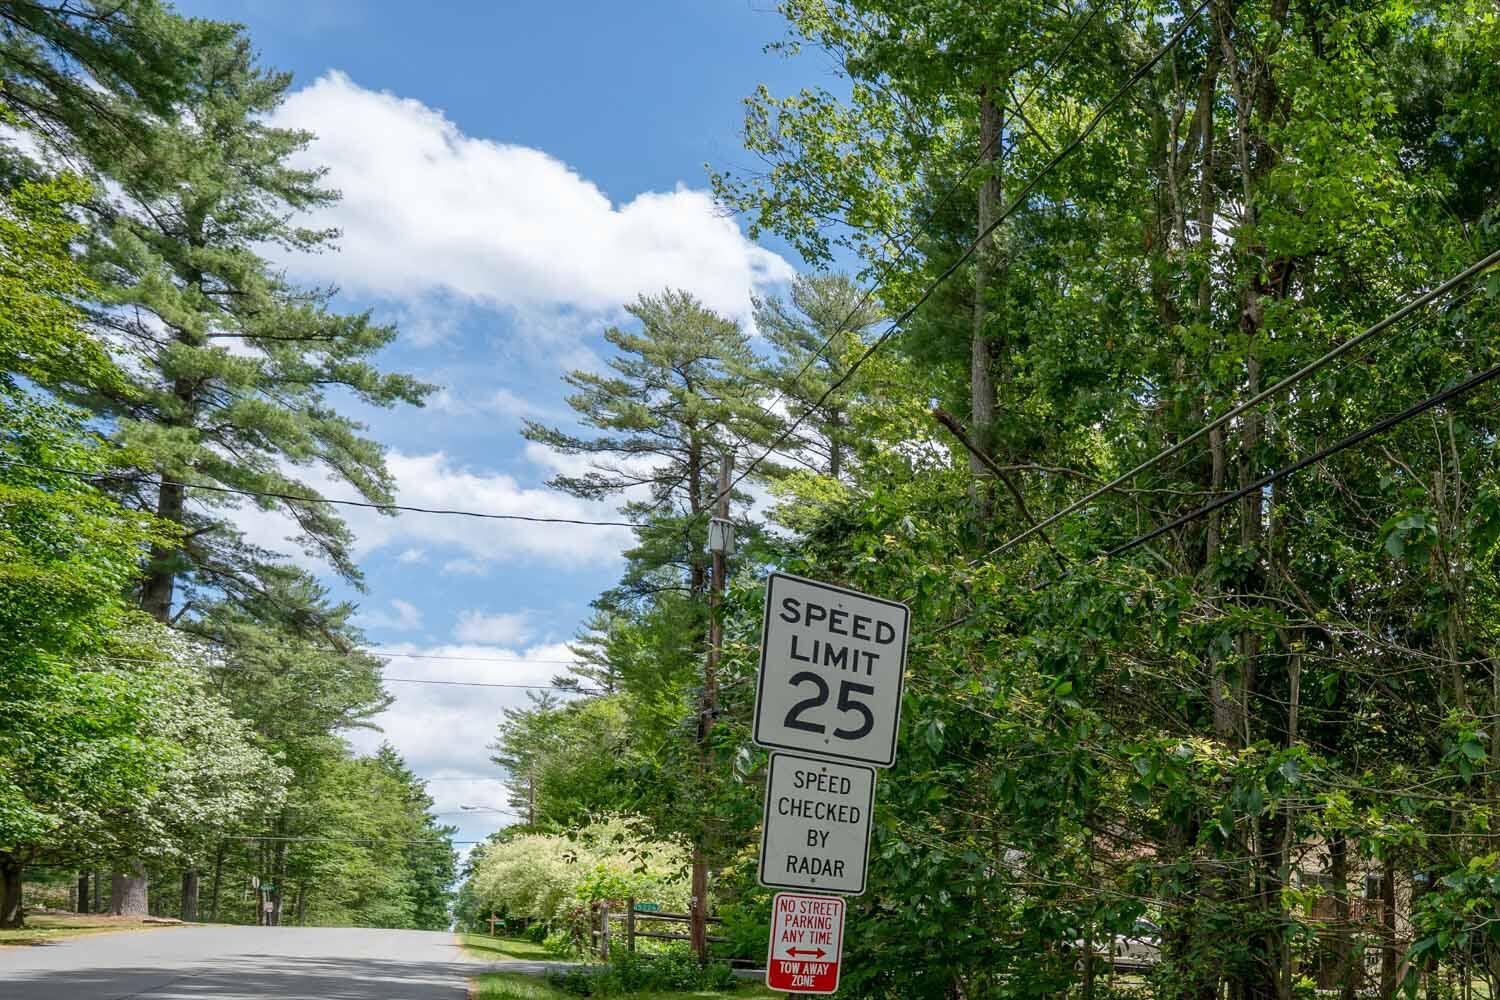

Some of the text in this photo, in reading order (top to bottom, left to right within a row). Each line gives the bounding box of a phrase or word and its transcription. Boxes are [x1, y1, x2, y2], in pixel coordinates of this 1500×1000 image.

[779, 598, 896, 645] SPEED
[790, 634, 880, 676] LIMIT
[783, 671, 875, 741] 25
[793, 770, 851, 795] SPEED
[778, 796, 861, 824] CHECKED
[807, 829, 830, 848] BY
[786, 855, 845, 878] RADAR
[780, 899, 839, 917] NO STREET
[785, 914, 832, 930] PARKING
[782, 930, 833, 945] ANY TIME
[780, 961, 829, 975] TOW AWAY
[791, 975, 815, 987] ZONE
